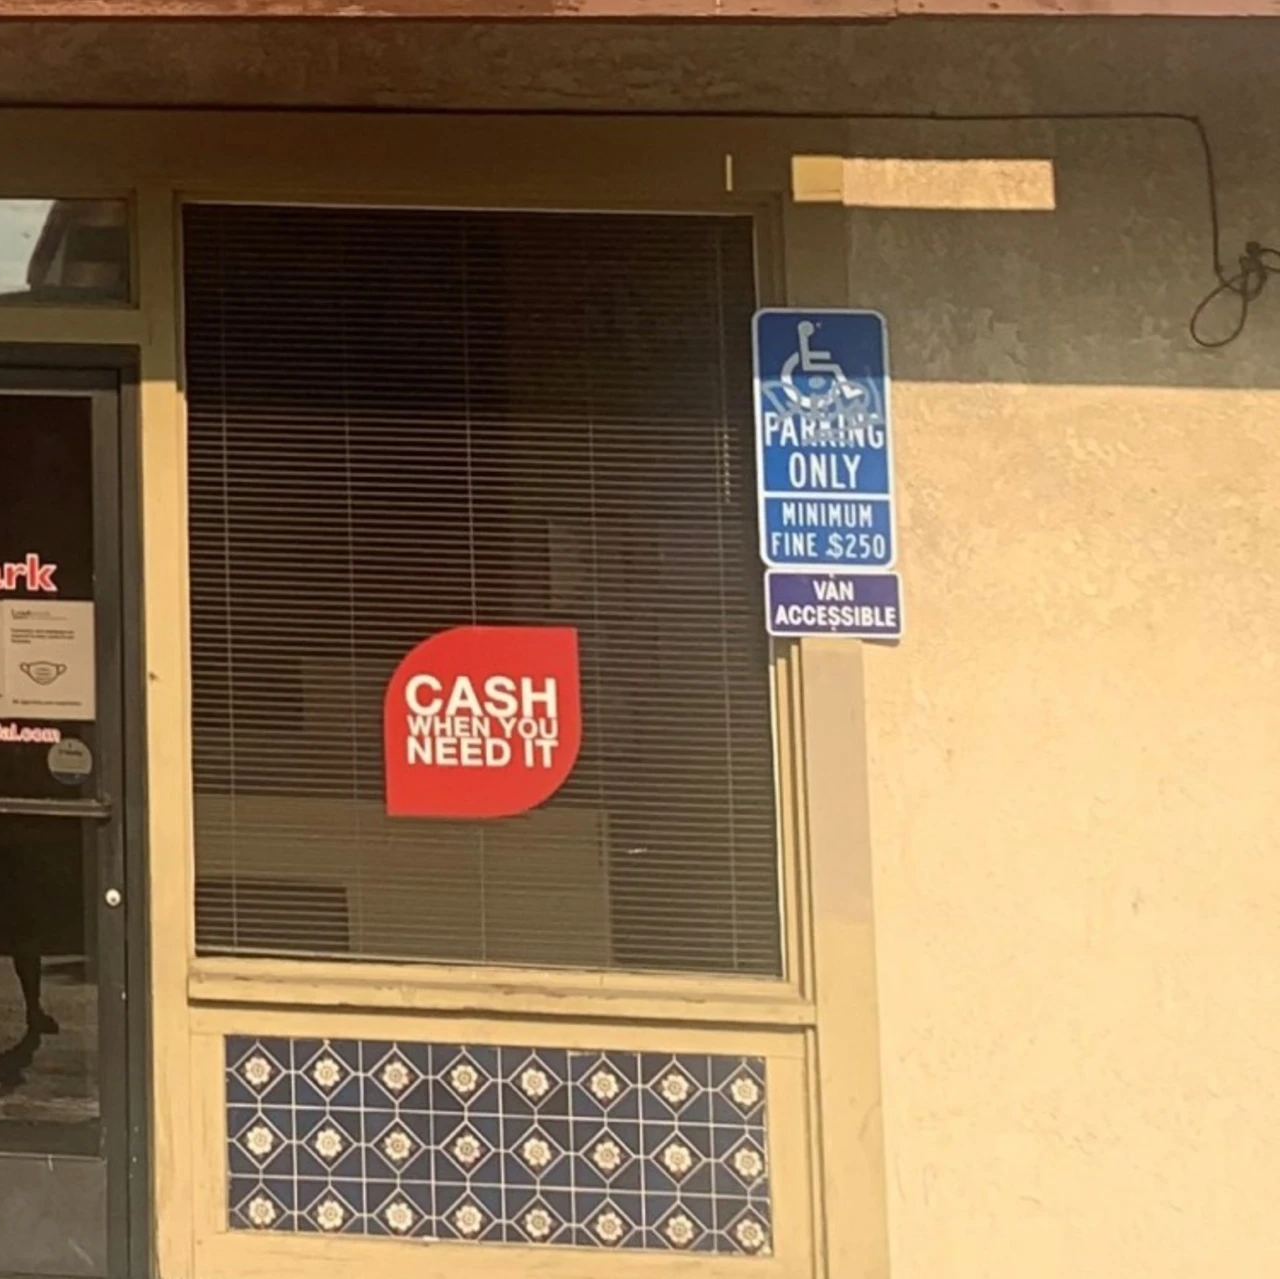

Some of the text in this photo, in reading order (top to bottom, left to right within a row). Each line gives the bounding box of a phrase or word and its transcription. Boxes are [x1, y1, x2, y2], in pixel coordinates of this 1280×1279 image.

[788, 451, 862, 489] ONLY
[781, 501, 874, 529] MINIMUM
[771, 532, 886, 560] FINE $250
[813, 580, 854, 601] VAN
[775, 604, 897, 628] ACCESSIBLE
[404, 674, 558, 718] CASH
[406, 715, 559, 740] WHEN YOU
[406, 735, 559, 768] NEED IT
